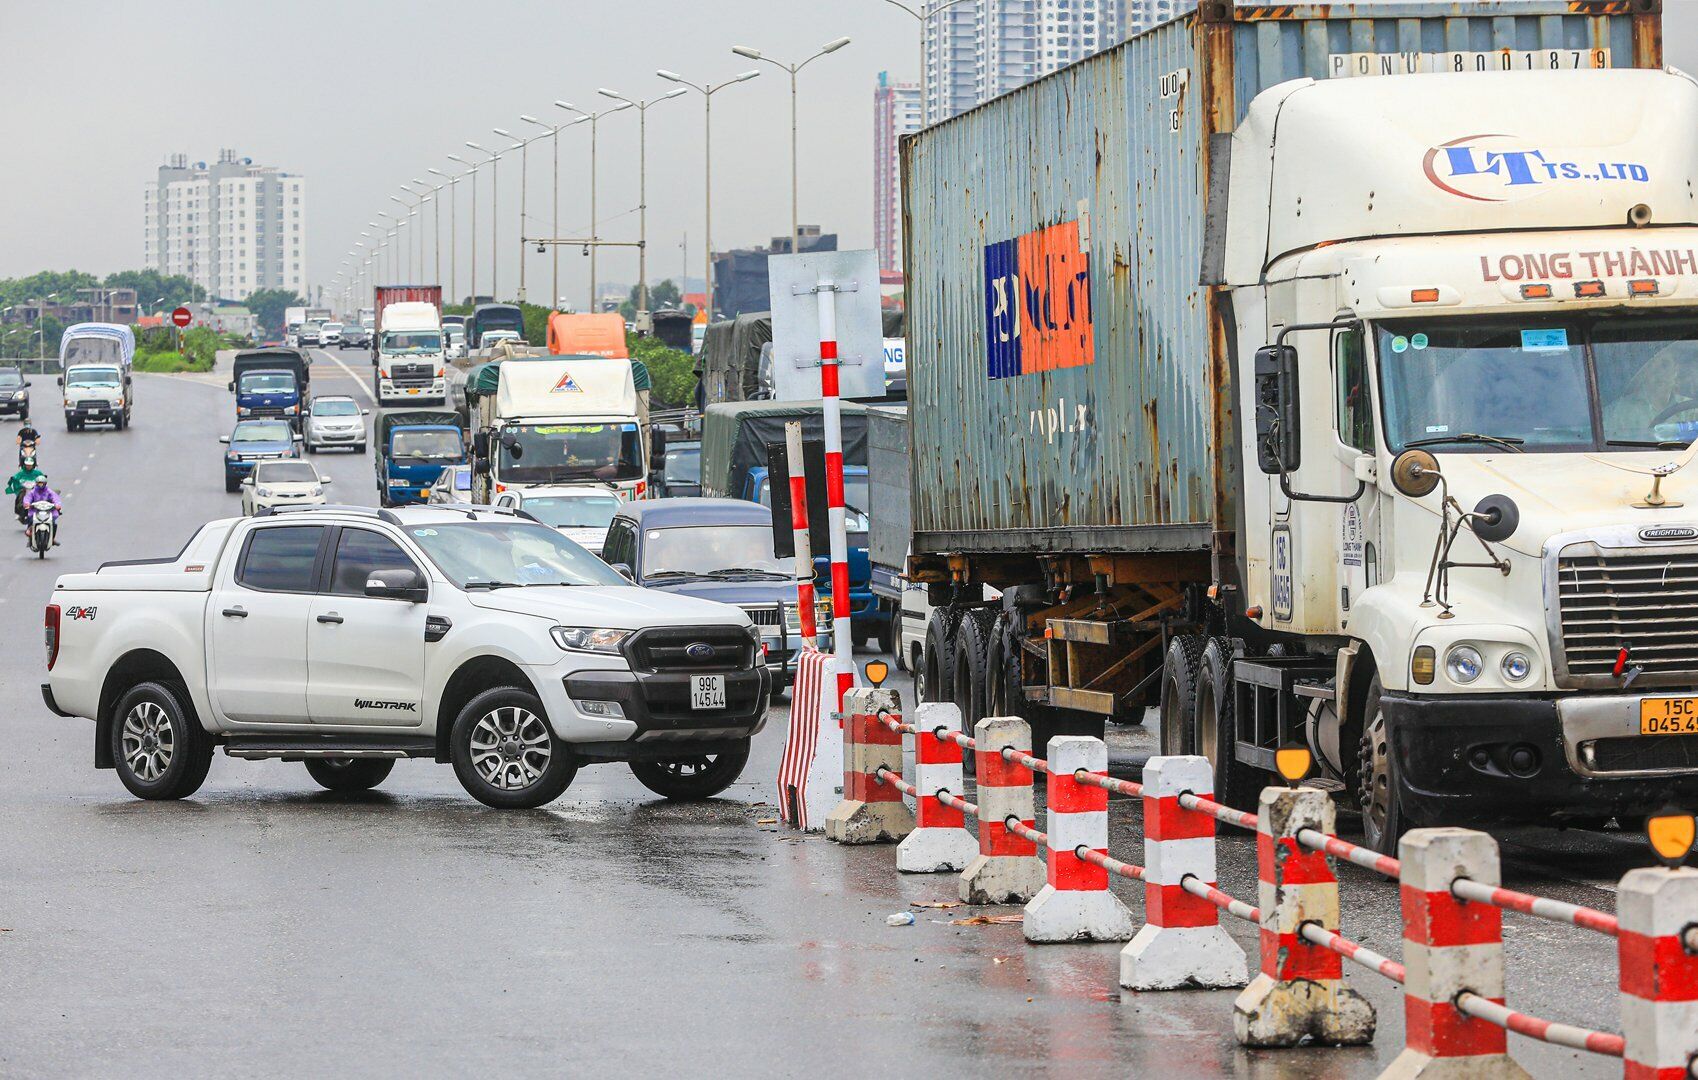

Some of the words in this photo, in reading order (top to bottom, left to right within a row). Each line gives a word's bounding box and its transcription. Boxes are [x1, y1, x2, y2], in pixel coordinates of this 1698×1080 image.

[1454, 50, 1606, 72] 8001879
[1480, 252, 1572, 282] LONG
[1578, 246, 1698, 278] THÀNH
[1646, 529, 1693, 537] FREIGHTLINER
[699, 677, 718, 691] 99C
[354, 698, 416, 712] WILDTRAK
[694, 692, 725, 707] 145.44
[1664, 700, 1694, 715] 15C
